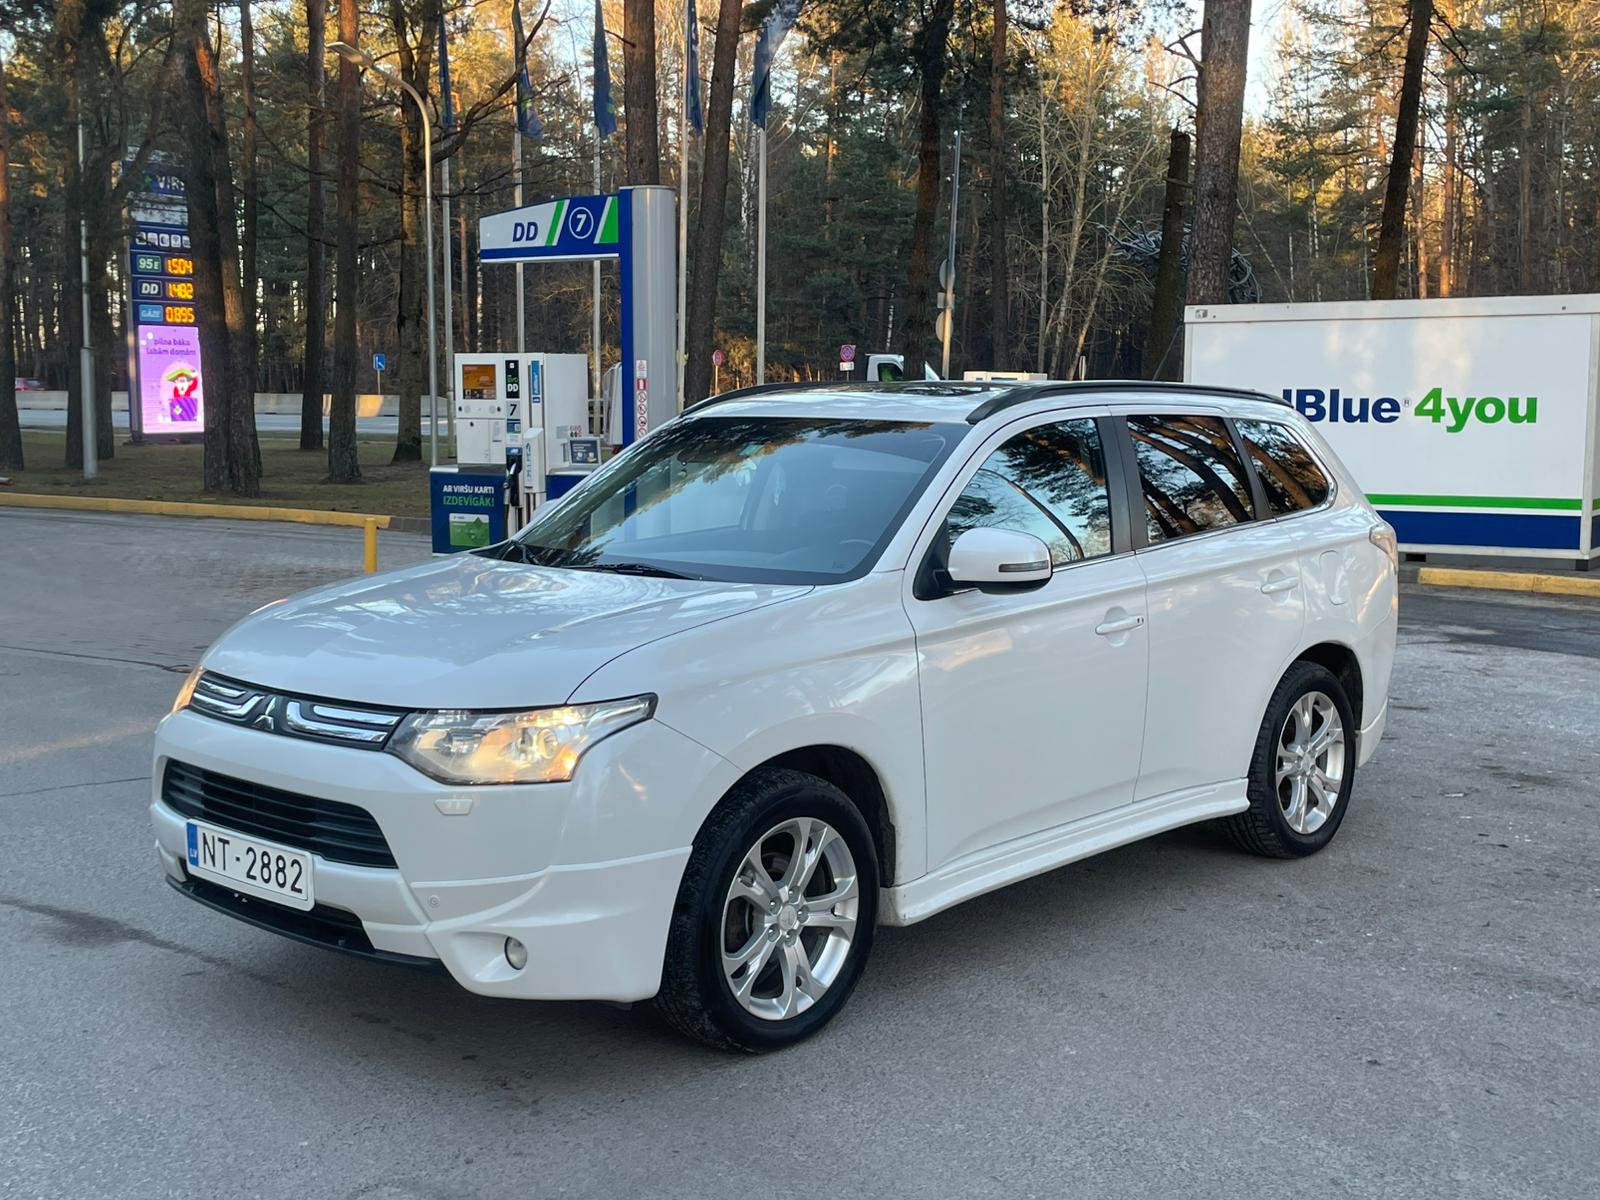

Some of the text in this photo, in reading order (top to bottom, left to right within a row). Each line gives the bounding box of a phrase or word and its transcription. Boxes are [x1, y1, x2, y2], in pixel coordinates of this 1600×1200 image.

[575, 213, 587, 233] 7
[513, 222, 539, 242] DD
[141, 282, 160, 295] DD
[507, 383, 519, 393] DD
[509, 403, 518, 417] 7
[1283, 387, 1538, 433] Blue 4you
[443, 484, 495, 494] AR VIRŠU KARTI
[443, 496, 495, 507] IZDEVĪGĀK!
[189, 848, 198, 858] LV
